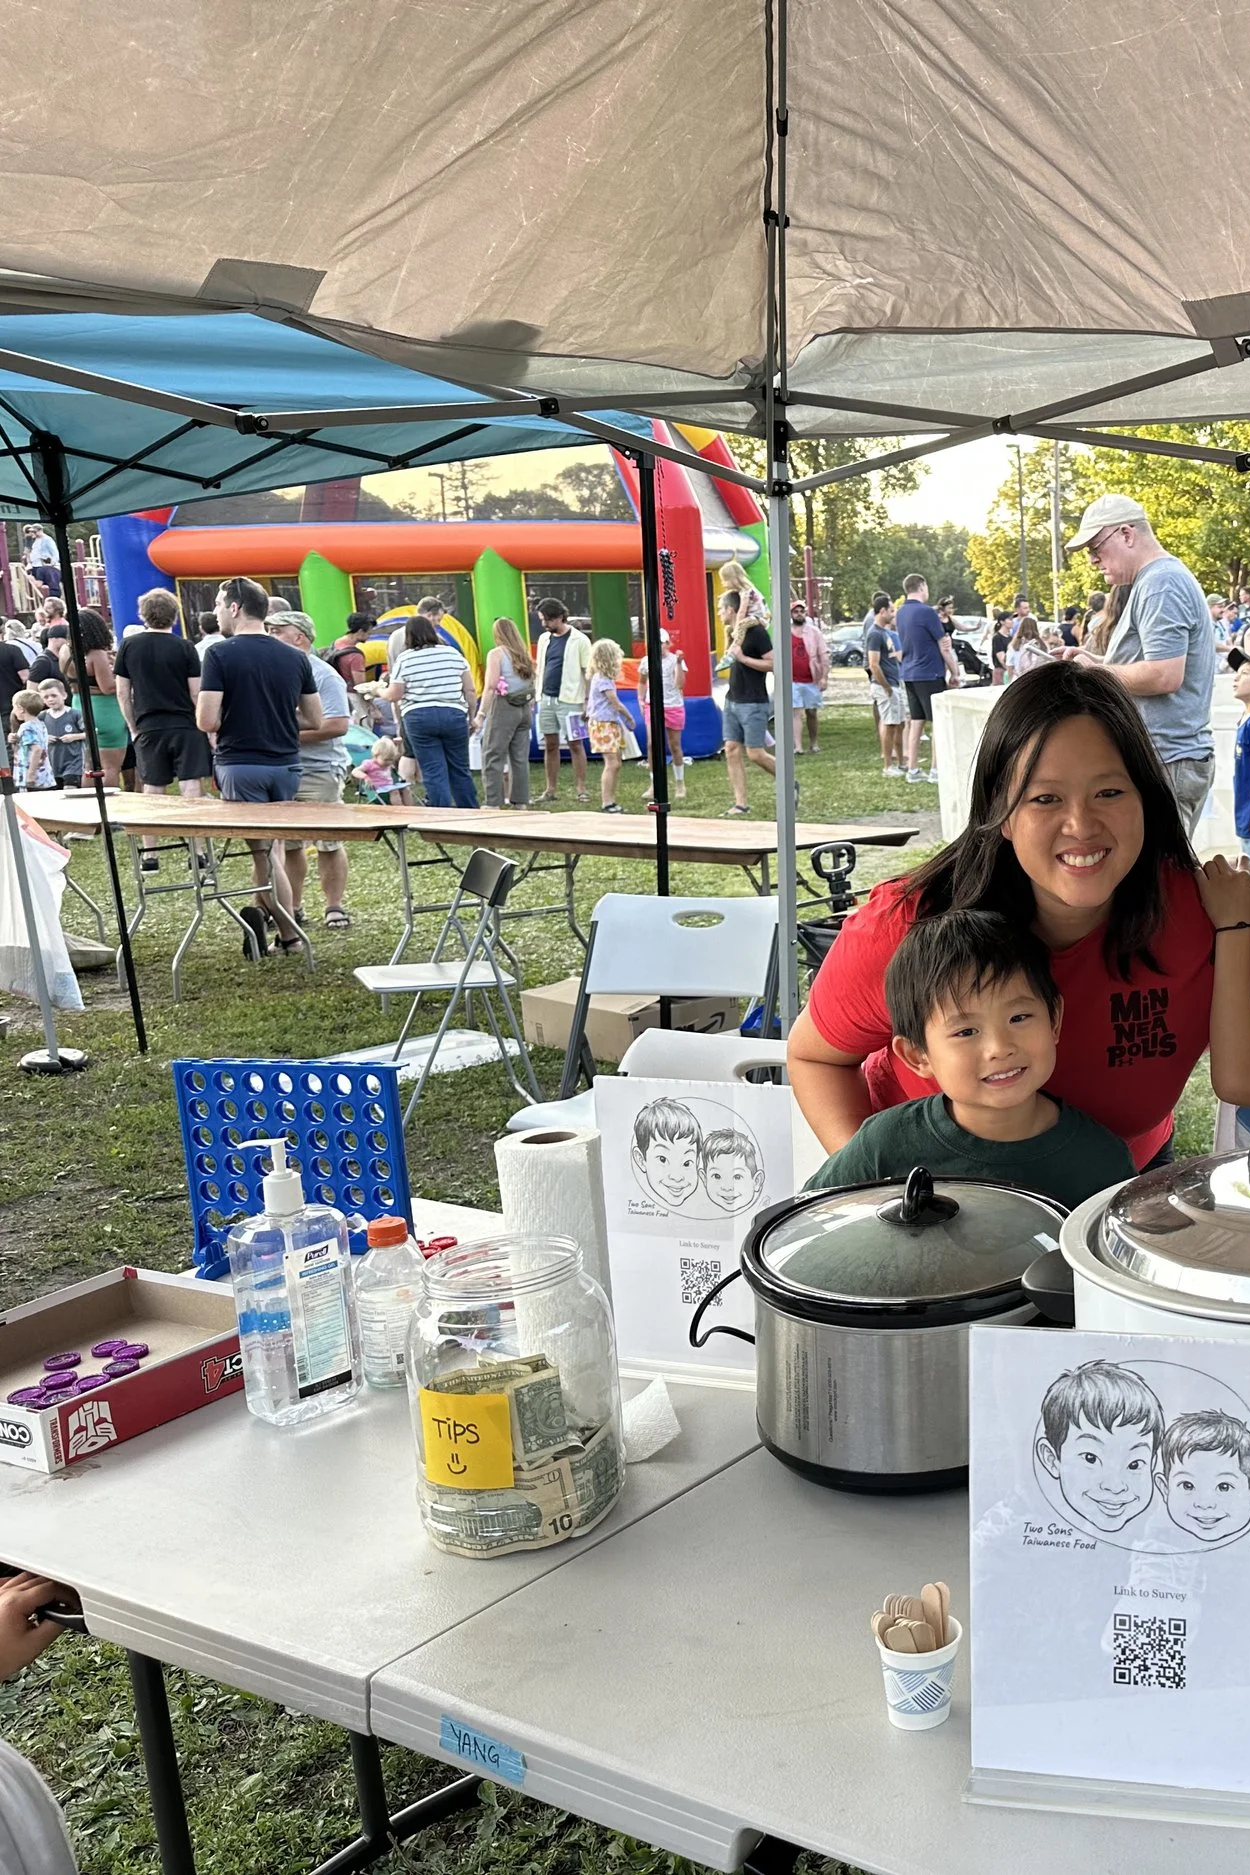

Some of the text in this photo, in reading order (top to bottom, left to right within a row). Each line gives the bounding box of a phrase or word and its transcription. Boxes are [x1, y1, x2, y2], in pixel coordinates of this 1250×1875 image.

[627, 1199, 639, 1207] Two
[679, 1240, 692, 1248] Link
[700, 1242, 720, 1251] Survey
[49, 1417, 62, 1464] TRANSFORMERS
[548, 1513, 573, 1536] 10
[1023, 1522, 1073, 1536] Two Sons
[1022, 1535, 1097, 1550] Taiwanese Food
[1114, 1586, 1187, 1603] Link to Survey
[450, 1723, 500, 1768] YANG
